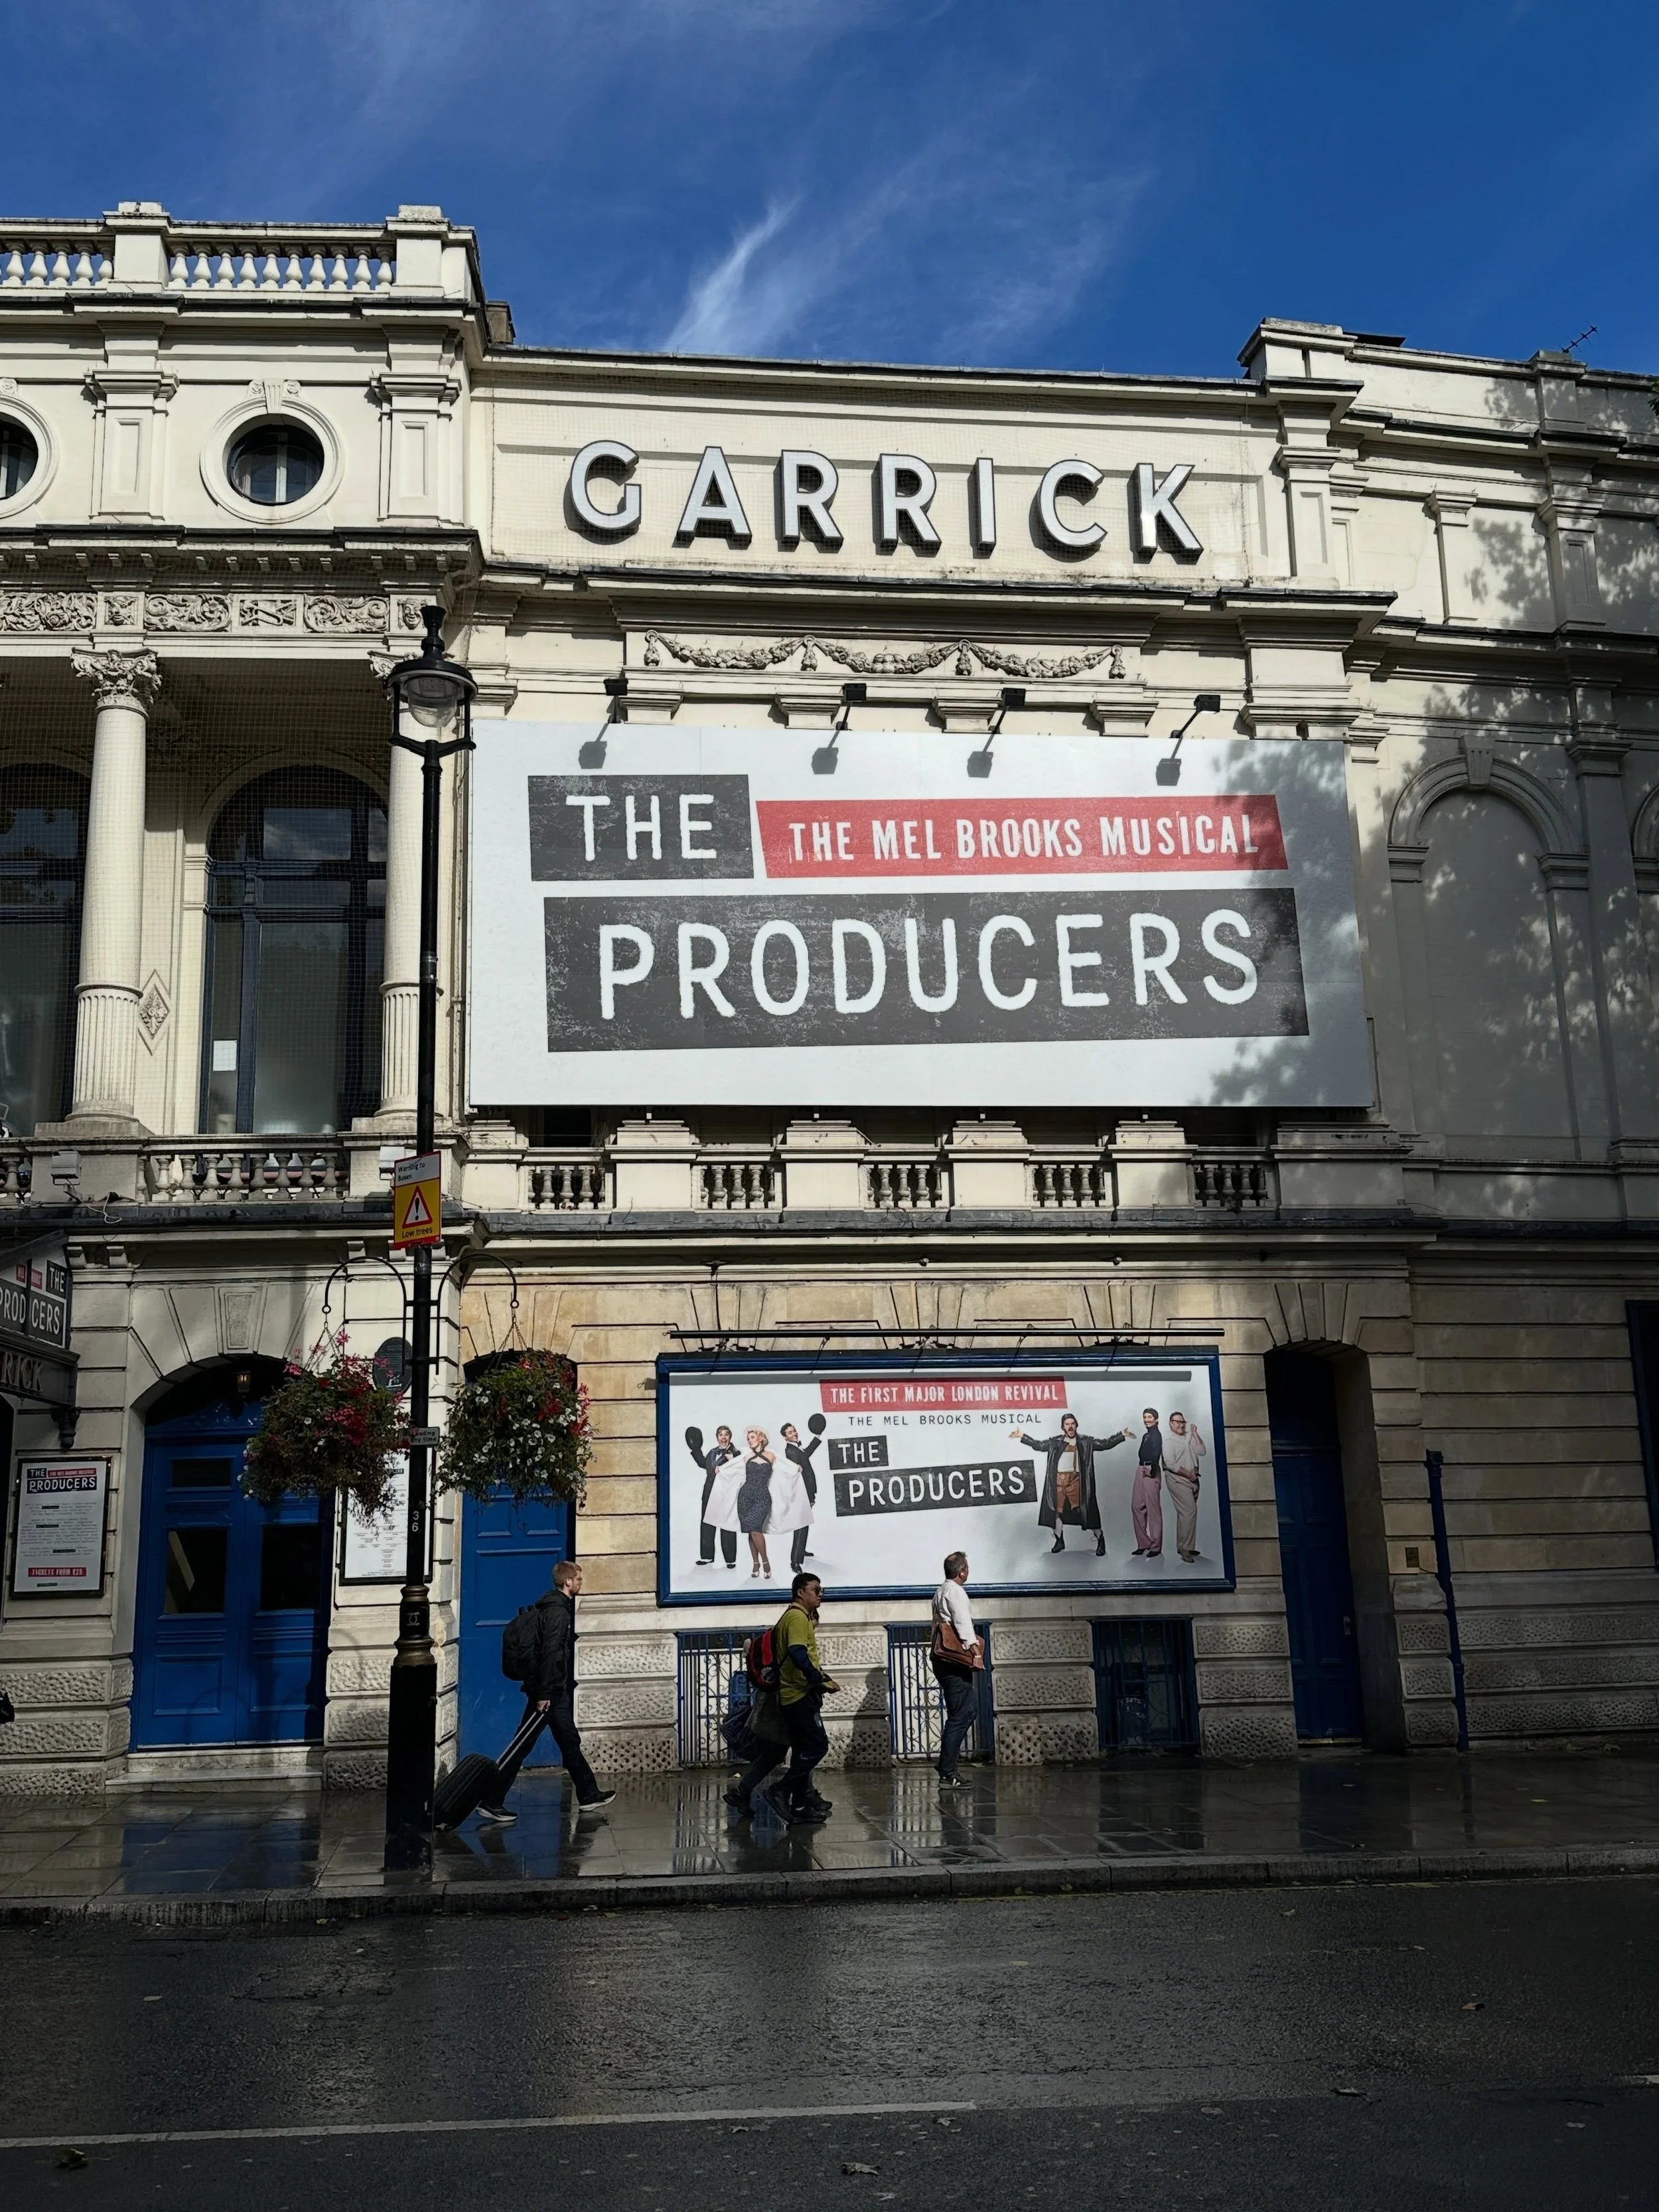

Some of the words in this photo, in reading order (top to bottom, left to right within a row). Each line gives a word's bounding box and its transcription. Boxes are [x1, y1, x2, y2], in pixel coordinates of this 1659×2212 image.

[565, 439, 1204, 564] GARRICK
[565, 794, 717, 861] THE
[789, 821, 855, 862] THE
[871, 818, 942, 861] MEL
[956, 818, 1083, 859] BROOKS
[1100, 813, 1260, 857] MUSICAL
[599, 909, 1258, 1020] PRODUCERS
[401, 1230, 415, 1239] Low
[416, 1227, 433, 1236] trees
[50, 1266, 64, 1293] THE
[831, 1388, 855, 1404] THE
[861, 1386, 899, 1403] FIRST
[904, 1384, 945, 1402] MAJOR
[952, 1384, 999, 1402] LONDON
[1005, 1383, 1058, 1401] REVIVAL
[848, 1416, 873, 1426] THE
[884, 1416, 908, 1426] MEL
[920, 1414, 972, 1425] BROOKS
[981, 1414, 1041, 1424] MUSICAL
[837, 1441, 880, 1464] THE
[29, 1477, 96, 1491] PRODUCERS
[30, 1469, 45, 1477] THE
[849, 1465, 1025, 1508] PRODUCERS
